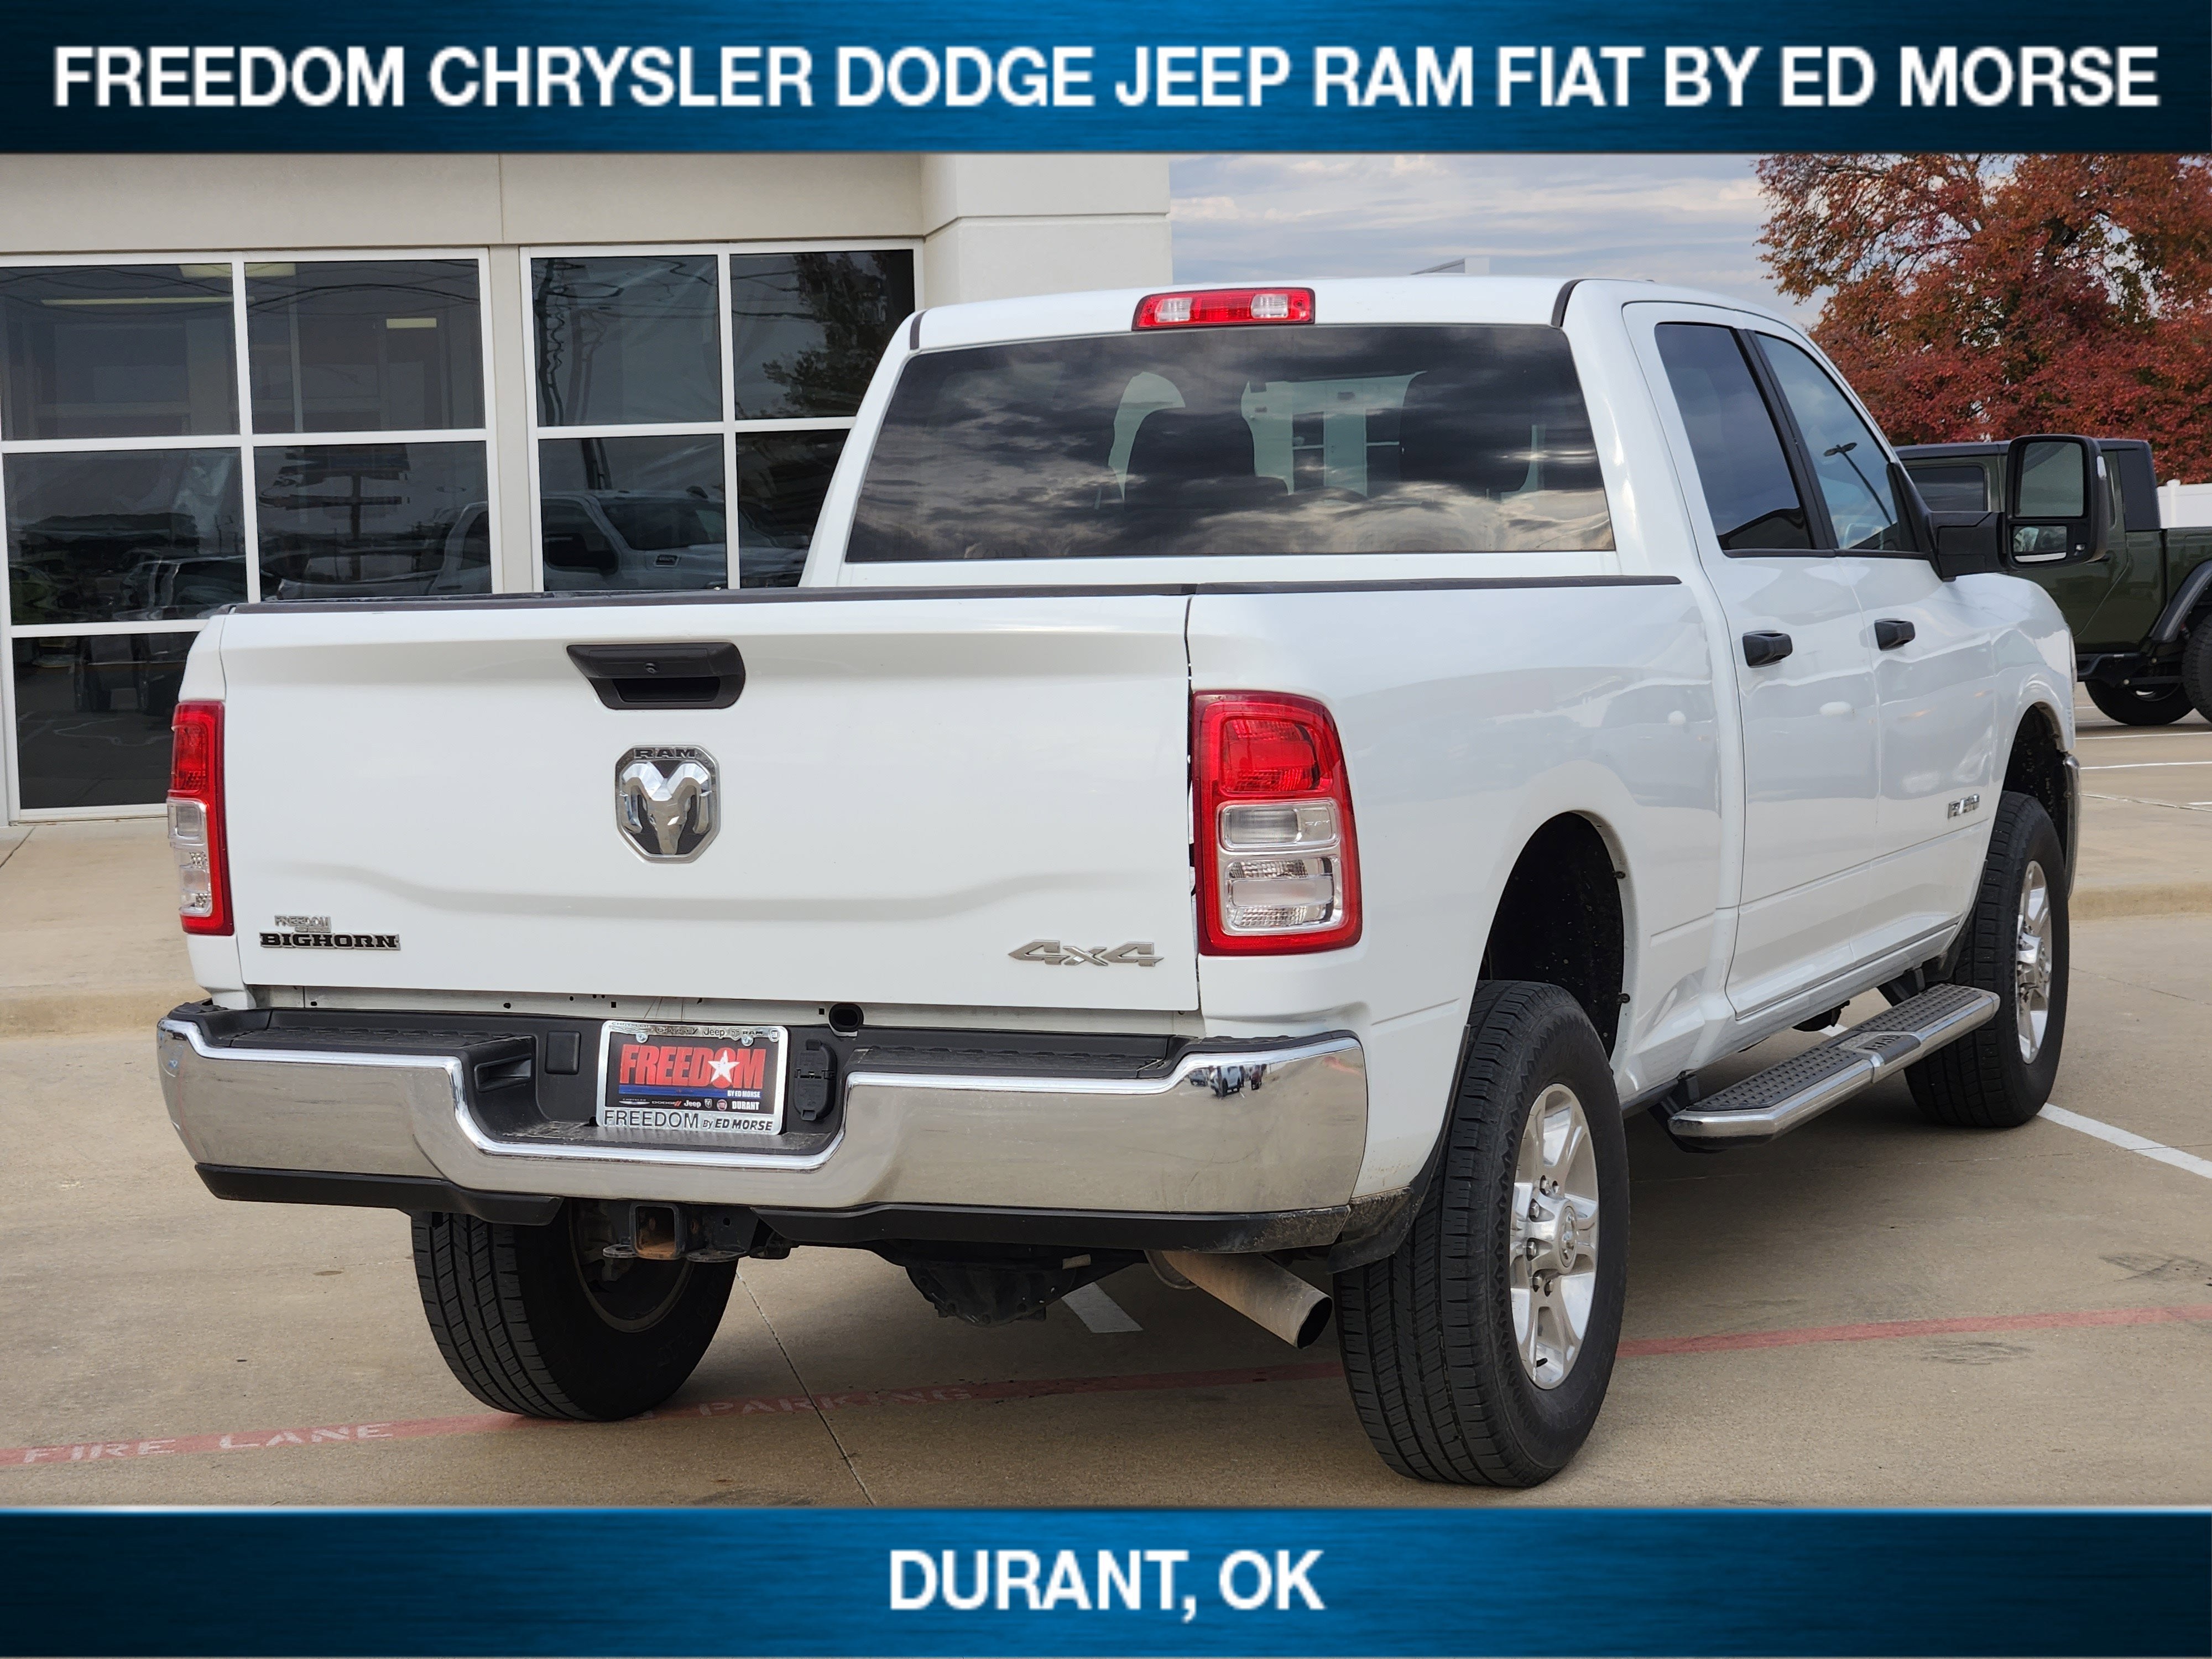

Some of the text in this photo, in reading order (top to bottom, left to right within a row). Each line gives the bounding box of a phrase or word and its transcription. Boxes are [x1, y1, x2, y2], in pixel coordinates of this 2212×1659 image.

[635, 749, 696, 758] RAM
[259, 932, 399, 950] BIGHORN
[1008, 940, 1164, 967] 4x4
[703, 1027, 725, 1039] Jeep
[732, 1101, 760, 1110] DURANT
[604, 1110, 698, 1129] FREEDOM
[714, 1118, 730, 1129] ED
[732, 1119, 773, 1131] MORSE
[24, 1424, 393, 1463] FIRE LANE
